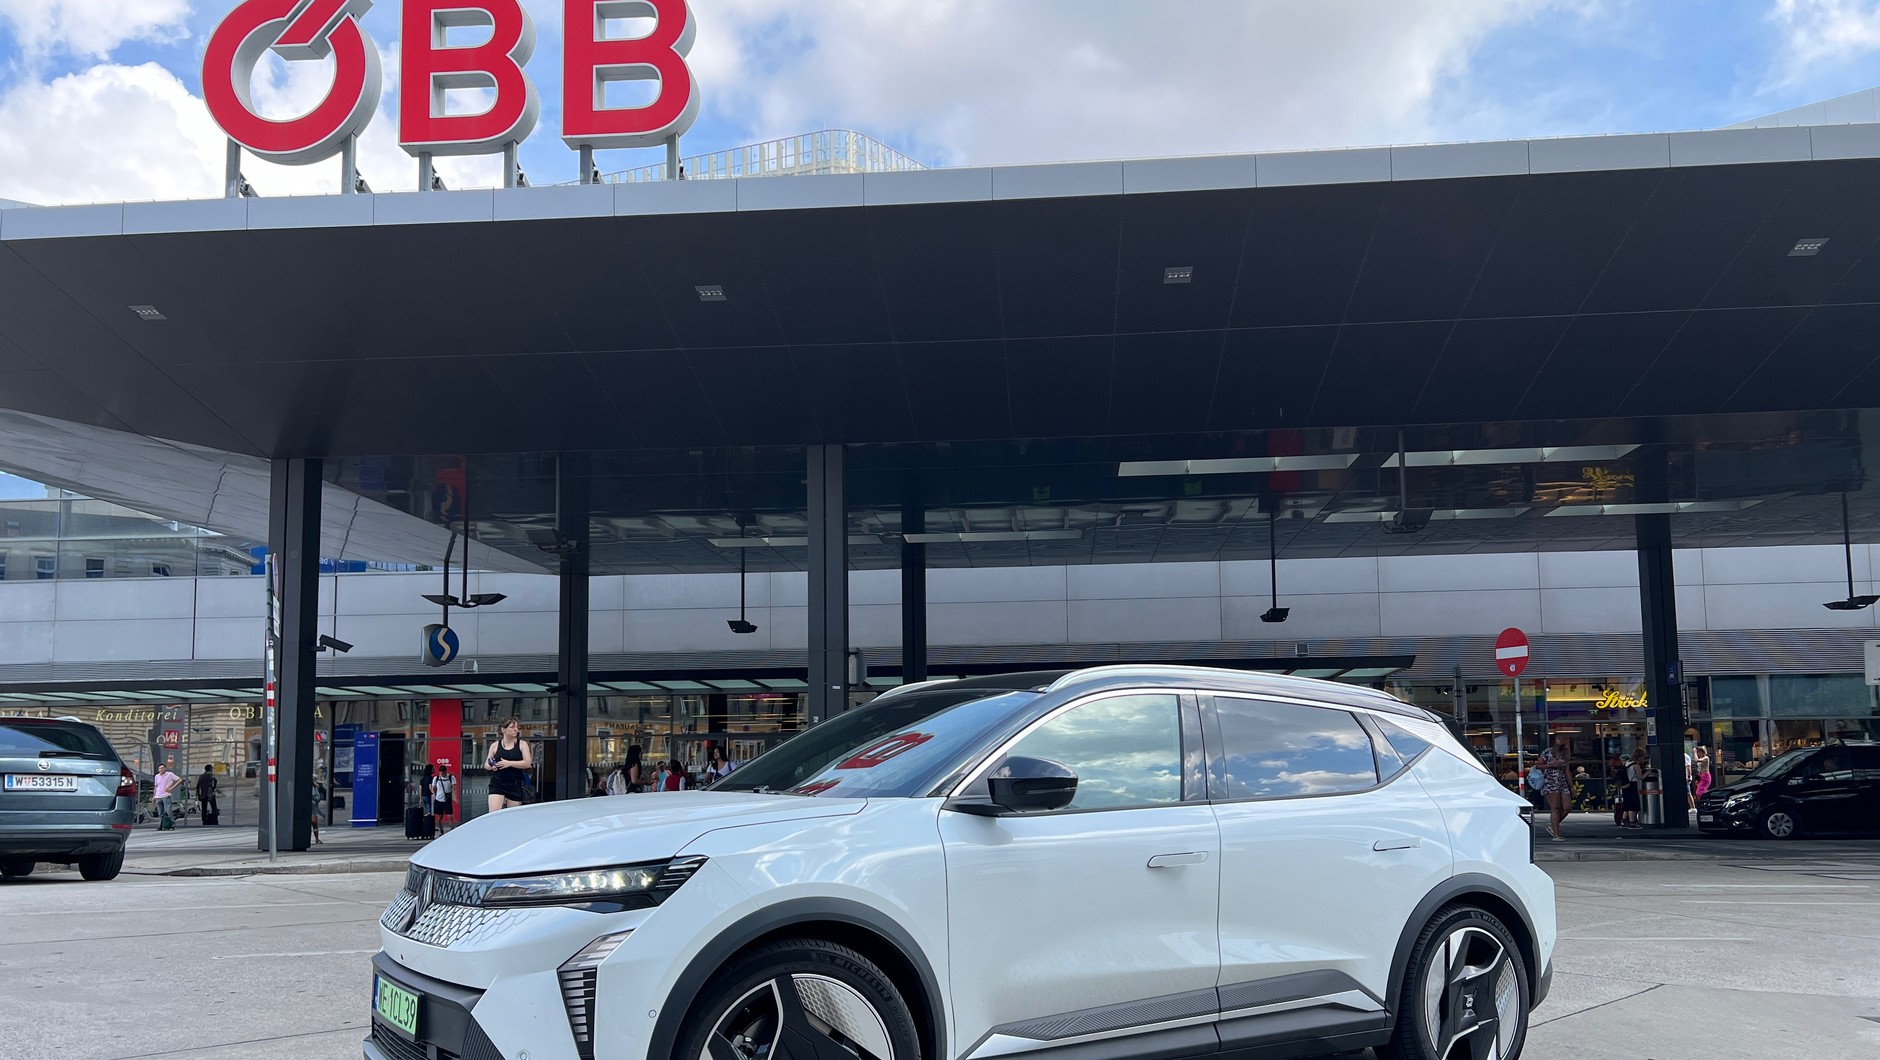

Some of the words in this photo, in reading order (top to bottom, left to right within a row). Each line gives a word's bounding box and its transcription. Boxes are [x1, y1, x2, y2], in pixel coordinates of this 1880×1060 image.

[1595, 689, 1648, 709] Ströck
[95, 709, 178, 721] Konditorei
[15, 777, 23, 787] W
[833, 957, 895, 1002] MICHELIN
[389, 987, 416, 1029] 1CL39
